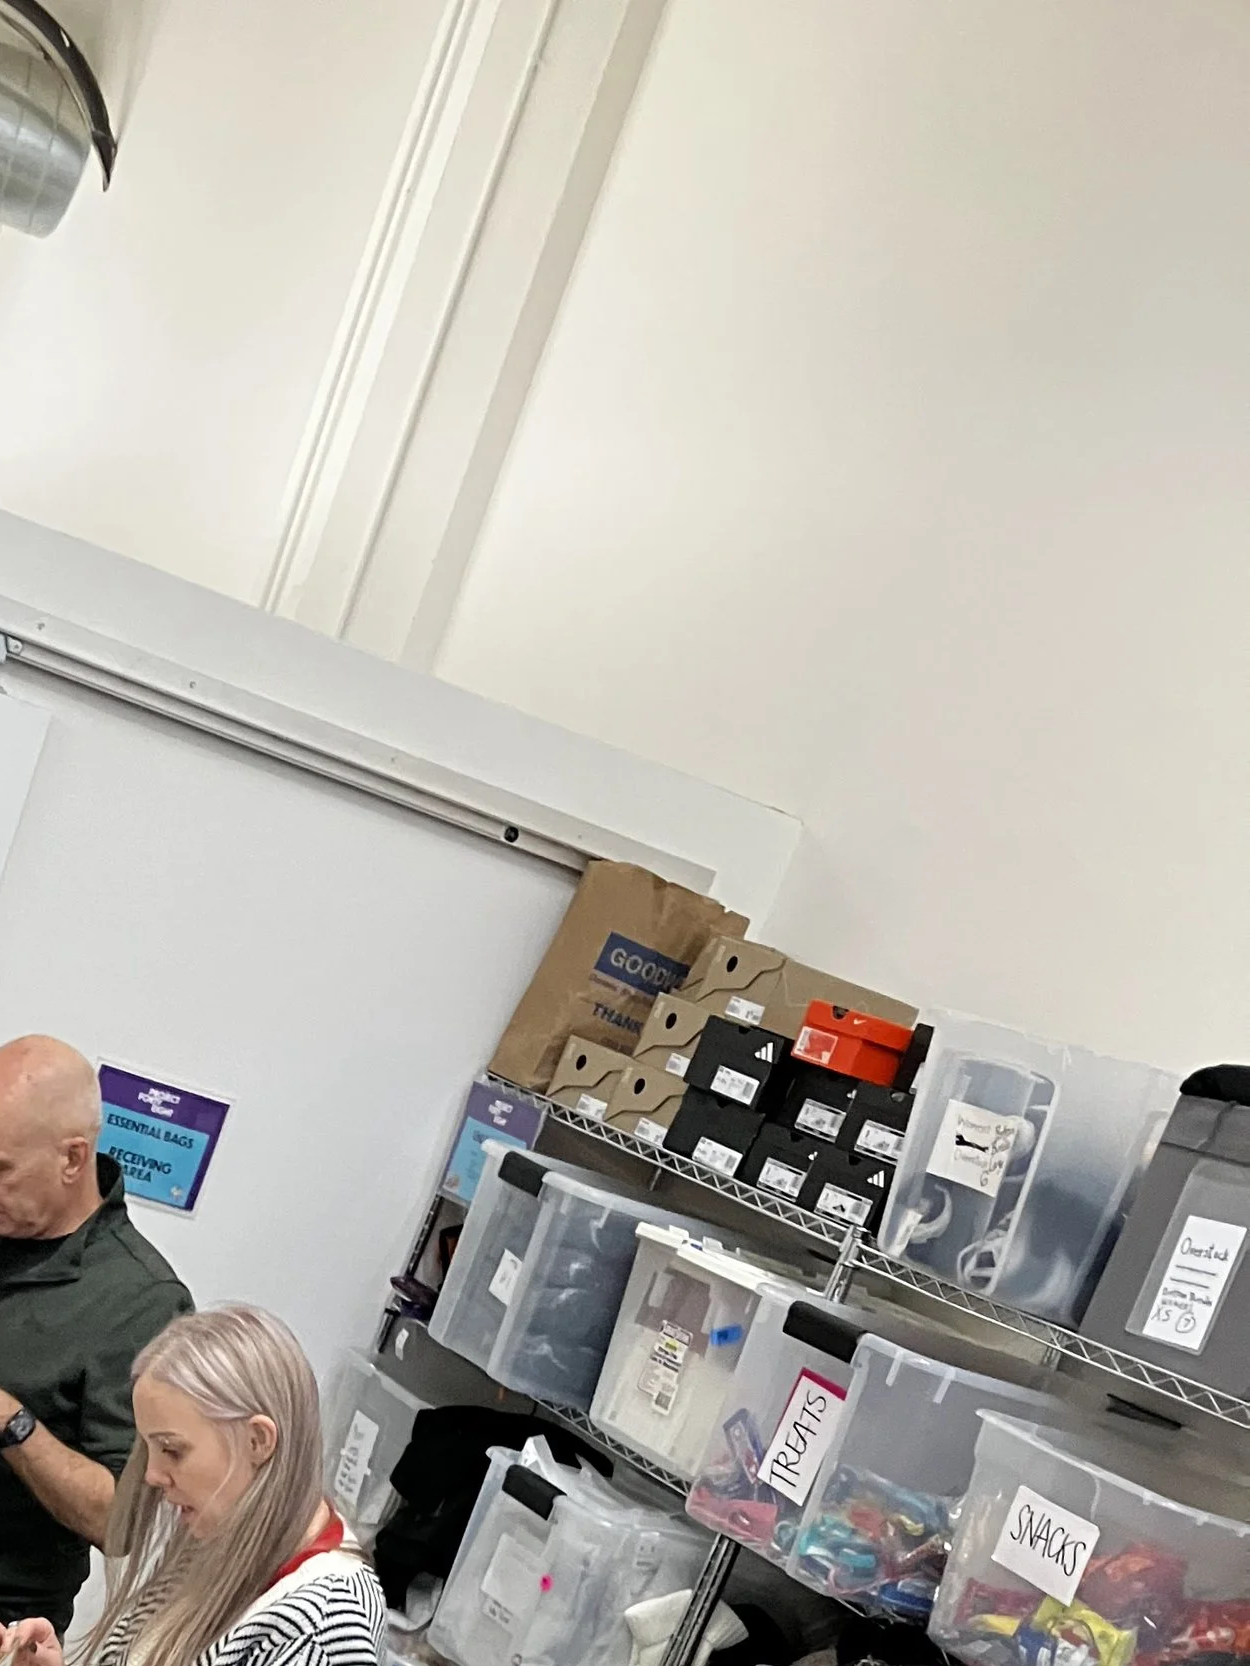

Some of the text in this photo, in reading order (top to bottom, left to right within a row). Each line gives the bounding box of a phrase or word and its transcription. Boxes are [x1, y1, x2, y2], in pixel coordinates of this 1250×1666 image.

[107, 1113, 195, 1149] ESSENTIAL BAGS
[108, 1146, 172, 1175] RECEIVING
[123, 1165, 152, 1183] AREA
[770, 1390, 827, 1488] TREATS
[1010, 1504, 1086, 1576] SNACKS
